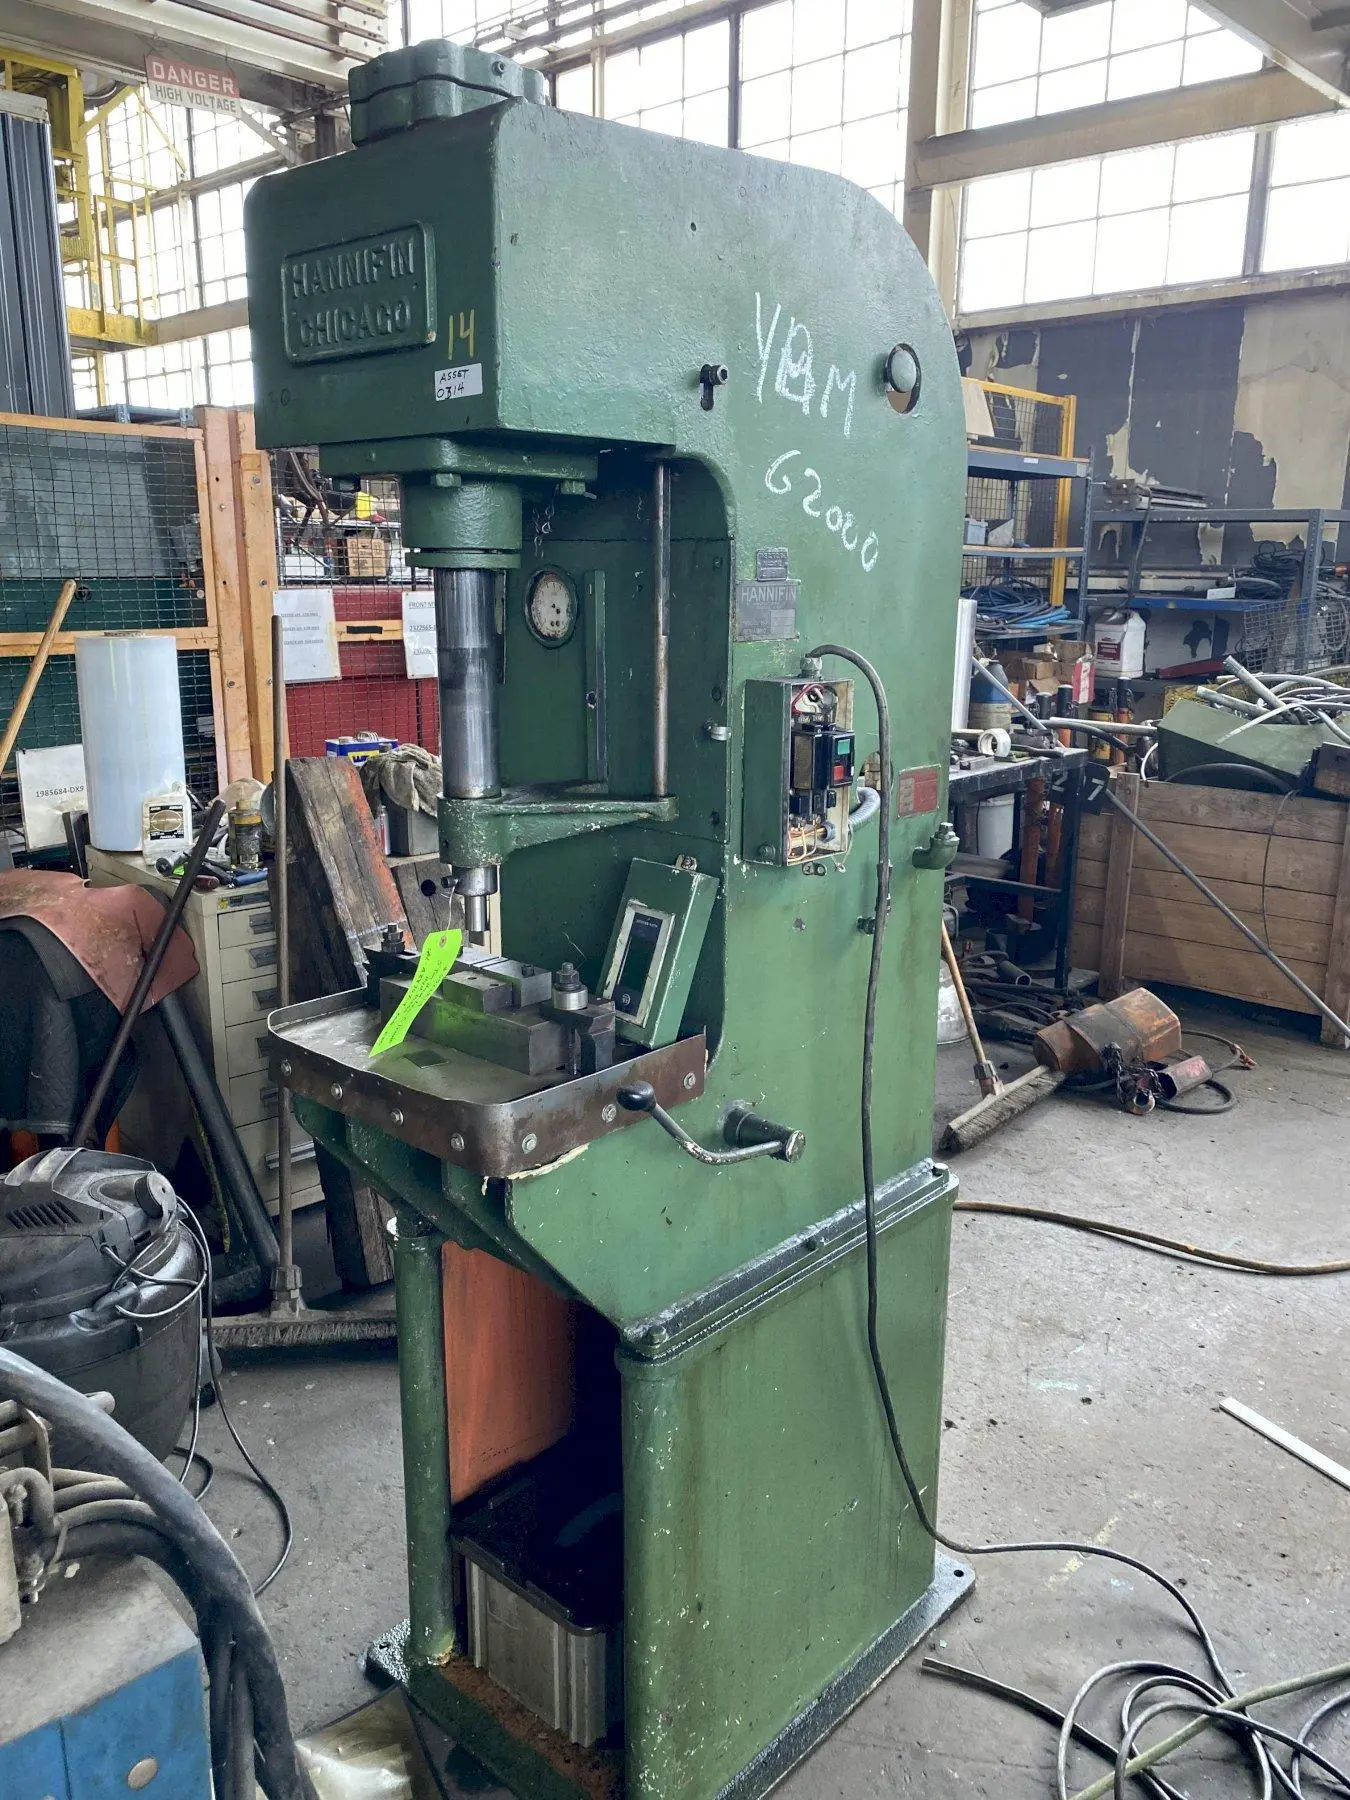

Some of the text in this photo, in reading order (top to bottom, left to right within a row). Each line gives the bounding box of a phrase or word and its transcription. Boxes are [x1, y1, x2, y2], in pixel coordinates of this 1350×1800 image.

[152, 61, 235, 95] DANGER
[156, 84, 237, 113] HIGH VOLTAGE
[293, 240, 415, 298] HANNIFIN
[300, 299, 412, 347] CHICAGO
[449, 308, 475, 360] 14
[440, 369, 470, 384] ASSET
[741, 586, 796, 605] HANNIFIN
[36, 785, 84, 798] 1985684-DX9
